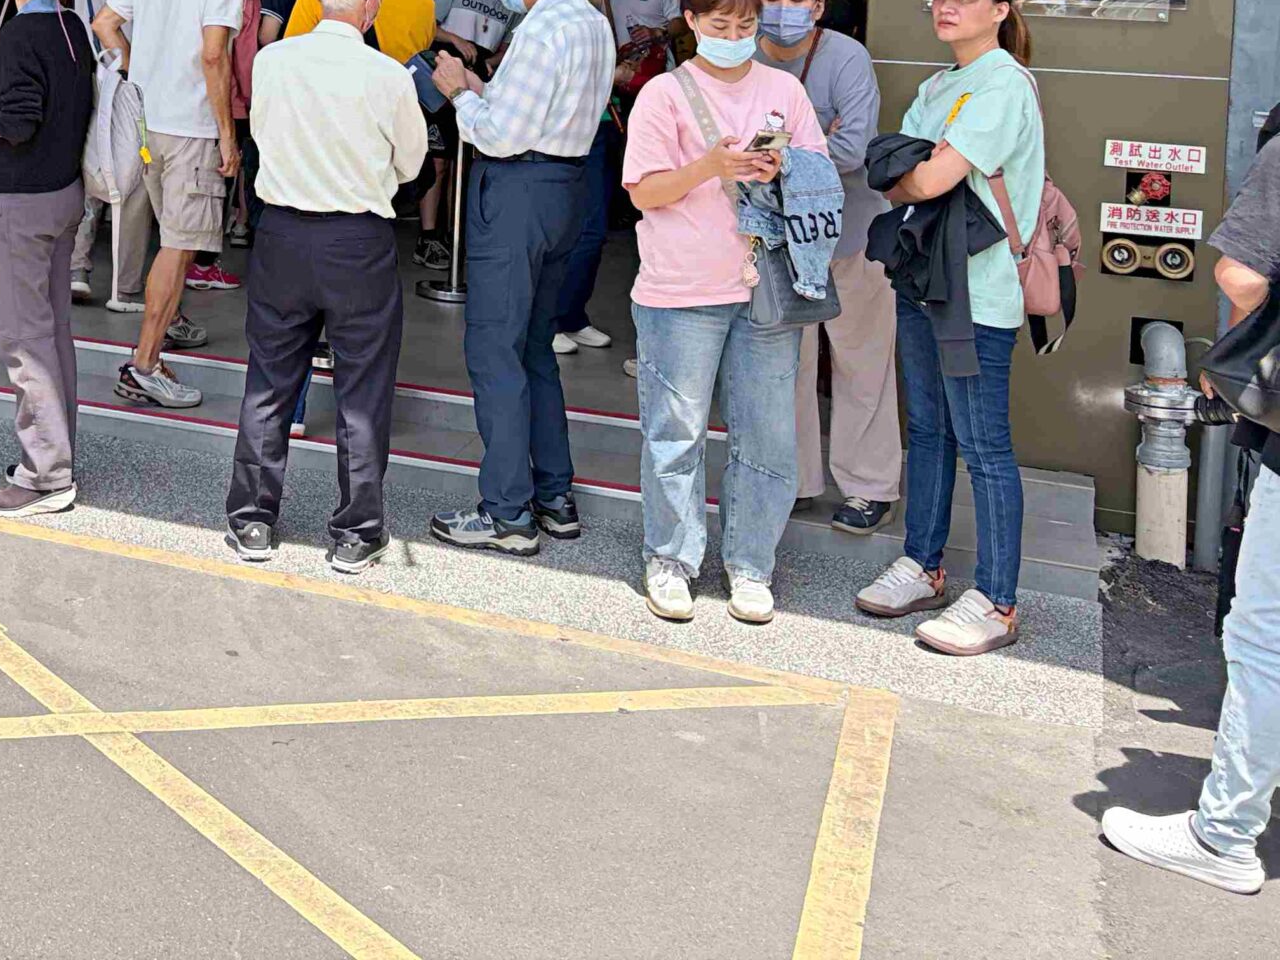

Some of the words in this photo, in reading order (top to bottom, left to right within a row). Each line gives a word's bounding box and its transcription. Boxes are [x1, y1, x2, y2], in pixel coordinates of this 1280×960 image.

[1109, 141, 1202, 163] 測試出水口
[1113, 157, 1133, 166] Test
[1137, 159, 1163, 168] Water
[1165, 161, 1194, 172] Outlet
[1107, 206, 1197, 225] 消防送水口
[1107, 221, 1118, 229] FIRE
[1120, 222, 1152, 231] PROTECTION
[1154, 225, 1173, 233] WATER
[1175, 226, 1196, 235] SUPPLY
